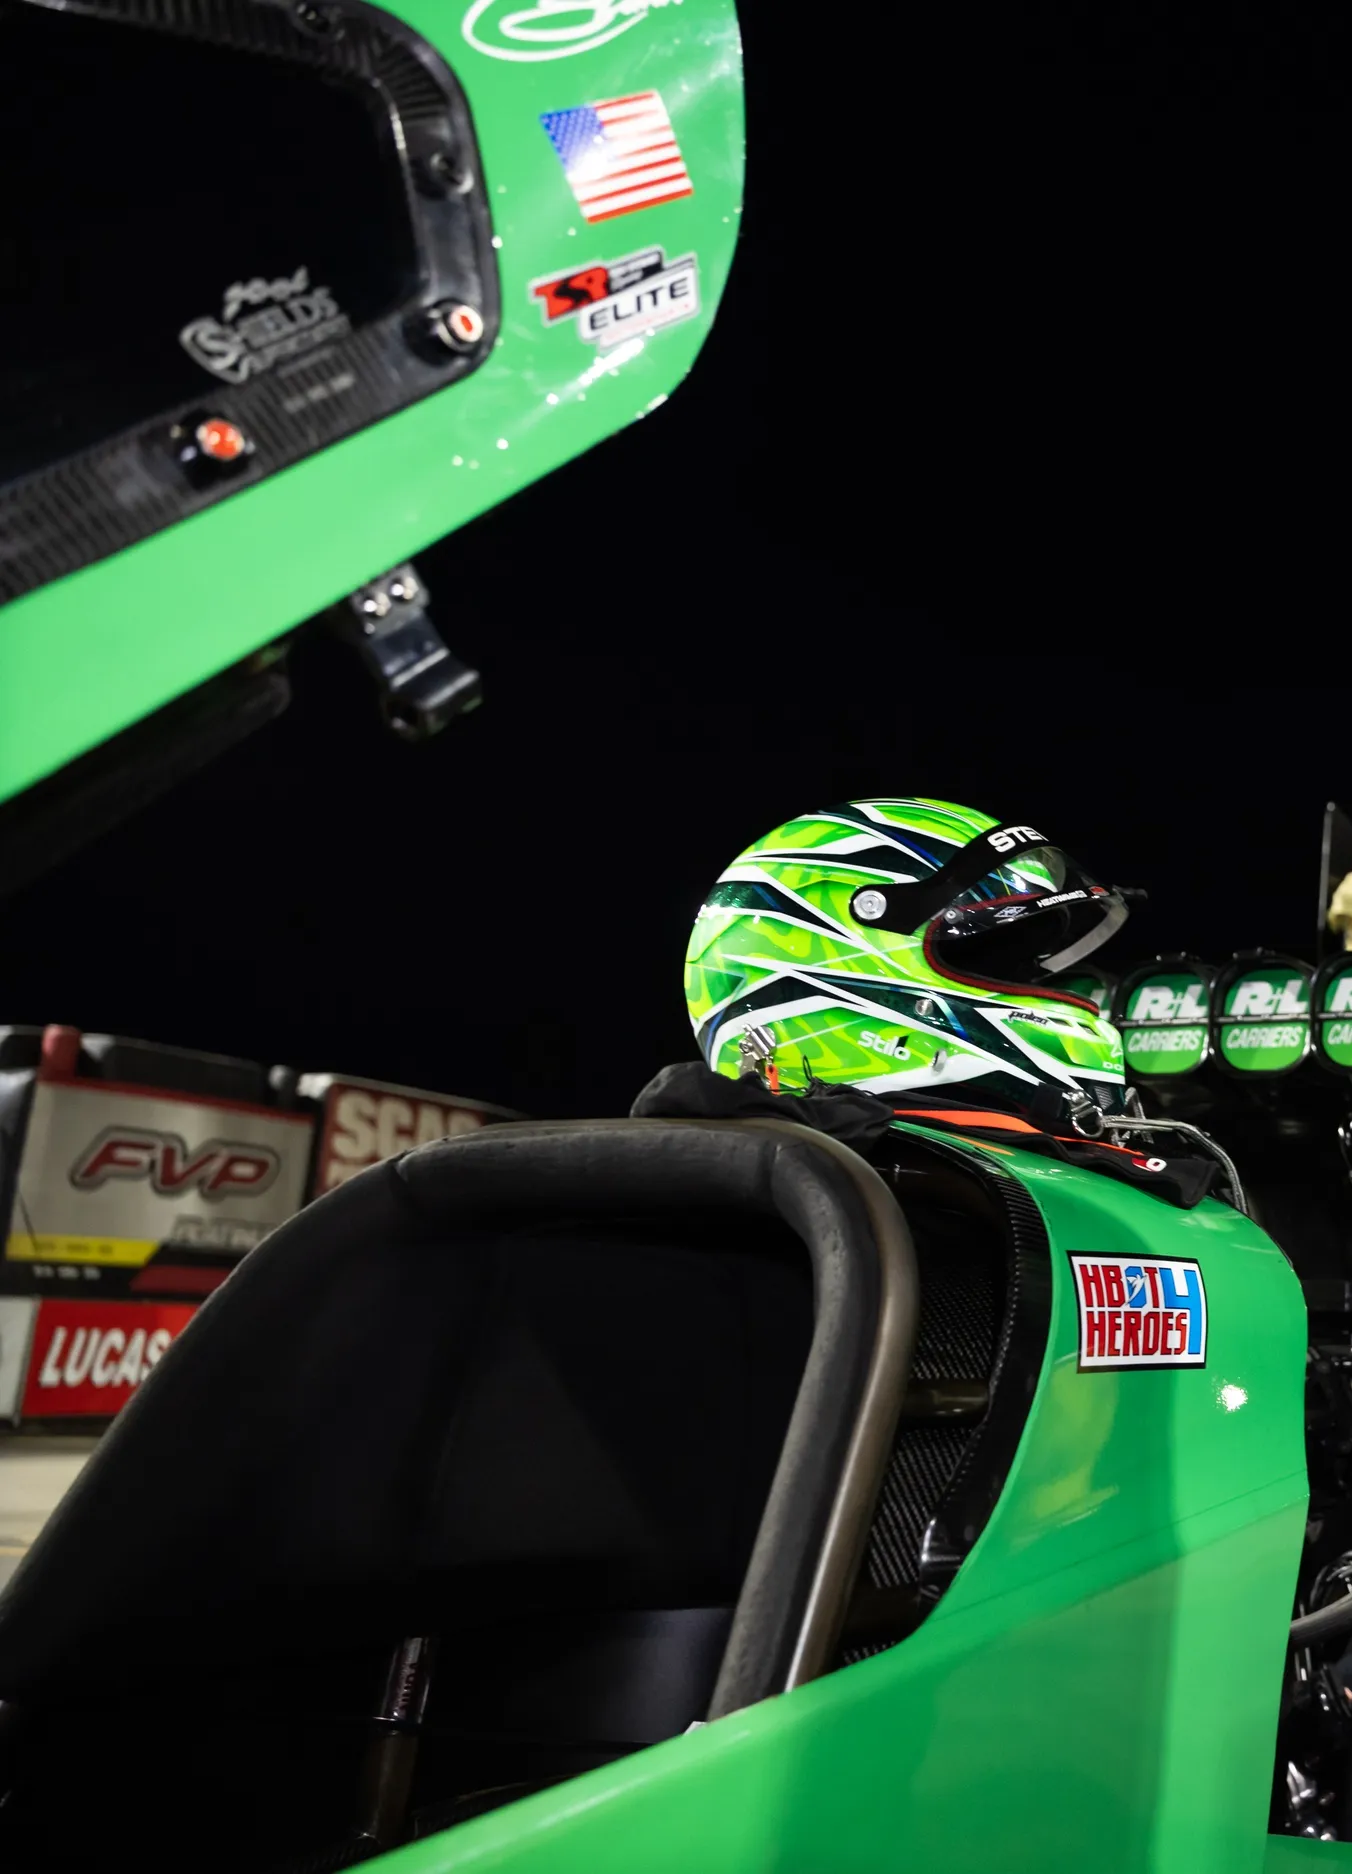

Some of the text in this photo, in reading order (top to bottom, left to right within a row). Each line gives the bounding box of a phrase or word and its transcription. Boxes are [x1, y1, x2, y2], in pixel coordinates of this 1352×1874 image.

[589, 276, 690, 331] ELITE
[987, 825, 1050, 852] STE
[1131, 984, 1208, 1019] R+L
[1230, 979, 1309, 1015] R+L
[858, 1030, 911, 1061] Stilo
[1127, 1029, 1201, 1053] CARRIERS
[1225, 1026, 1301, 1049] CARRIERS
[76, 1136, 274, 1194] FVP
[1086, 1311, 1188, 1358] HEROES
[38, 1326, 172, 1389] LUCAS
